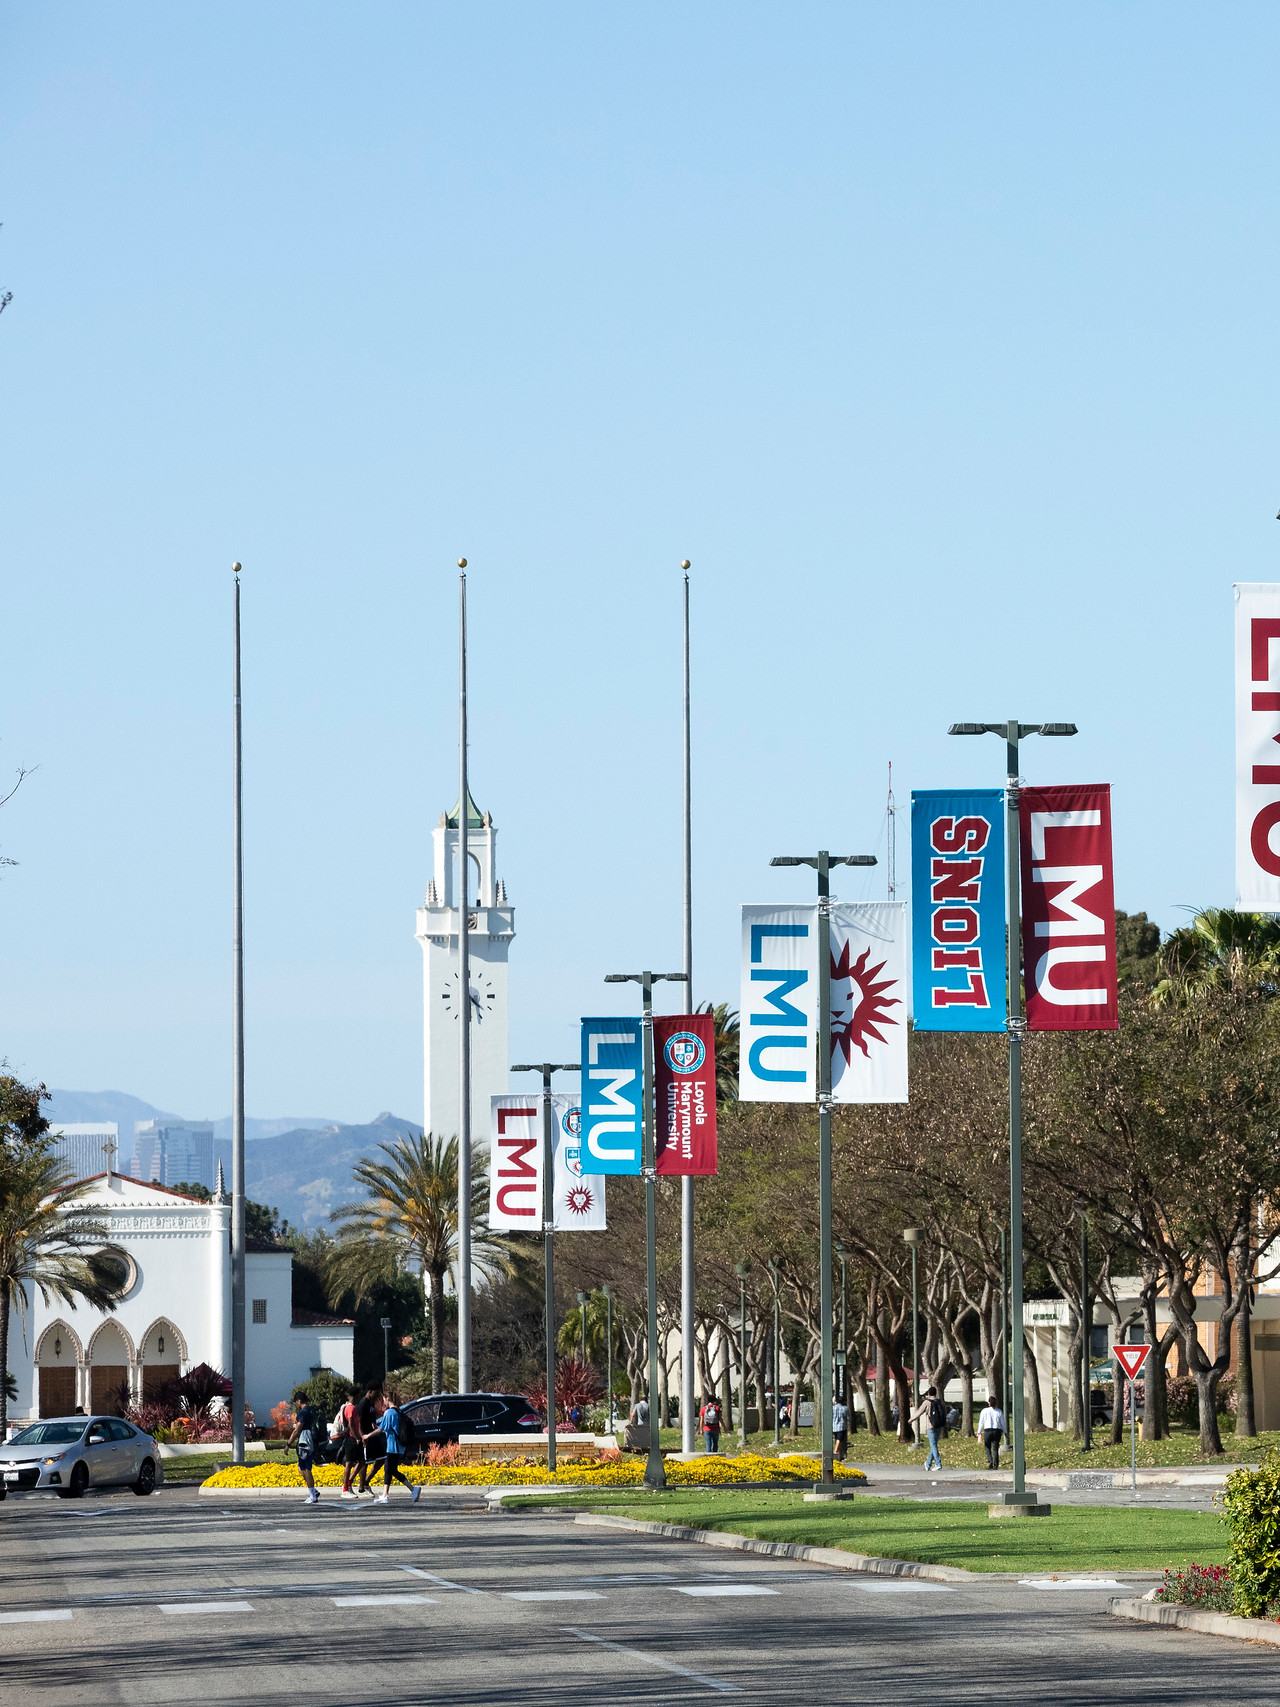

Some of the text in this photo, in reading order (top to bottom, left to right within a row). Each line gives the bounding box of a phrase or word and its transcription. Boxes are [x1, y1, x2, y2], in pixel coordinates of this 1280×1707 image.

[930, 815, 991, 1008] LIONS
[1030, 809, 1108, 1006] LMU
[748, 924, 809, 1083] LMU
[587, 1033, 636, 1160] LMU
[665, 1081, 680, 1151] University
[678, 1081, 693, 1160] Marymount
[693, 1081, 708, 1125] Loyola
[496, 1108, 537, 1216] LMU
